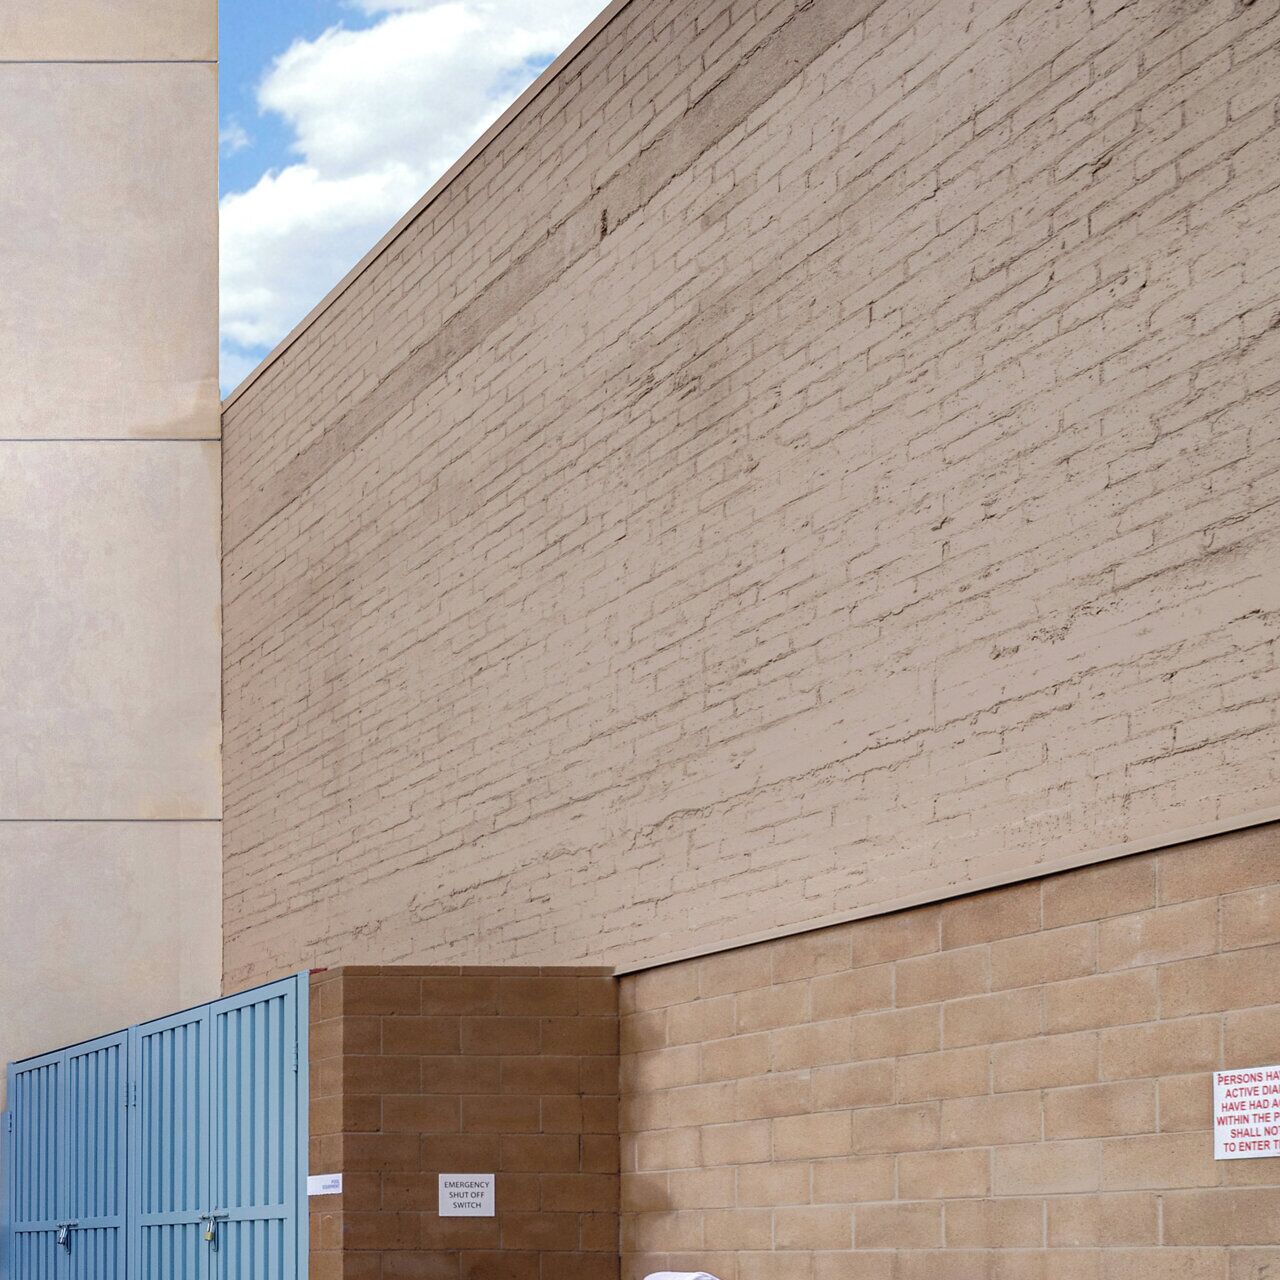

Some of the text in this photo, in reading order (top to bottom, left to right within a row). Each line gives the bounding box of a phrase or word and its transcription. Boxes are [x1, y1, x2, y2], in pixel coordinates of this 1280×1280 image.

[1218, 1072, 1263, 1085] PERSONS
[1225, 1086, 1259, 1099] ACTIVE
[1222, 1101, 1246, 1112] HAVE
[1249, 1099, 1270, 1110] HAD
[1216, 1114, 1249, 1126] WITHIN
[1252, 1112, 1271, 1123] THE
[1230, 1127, 1261, 1139] SHALL
[1223, 1142, 1236, 1152] TO
[1238, 1140, 1271, 1152] ENTER
[444, 1181, 489, 1189] EMERGENCY
[449, 1191, 485, 1199] SHUT OFF
[452, 1201, 481, 1209] SWITCH
